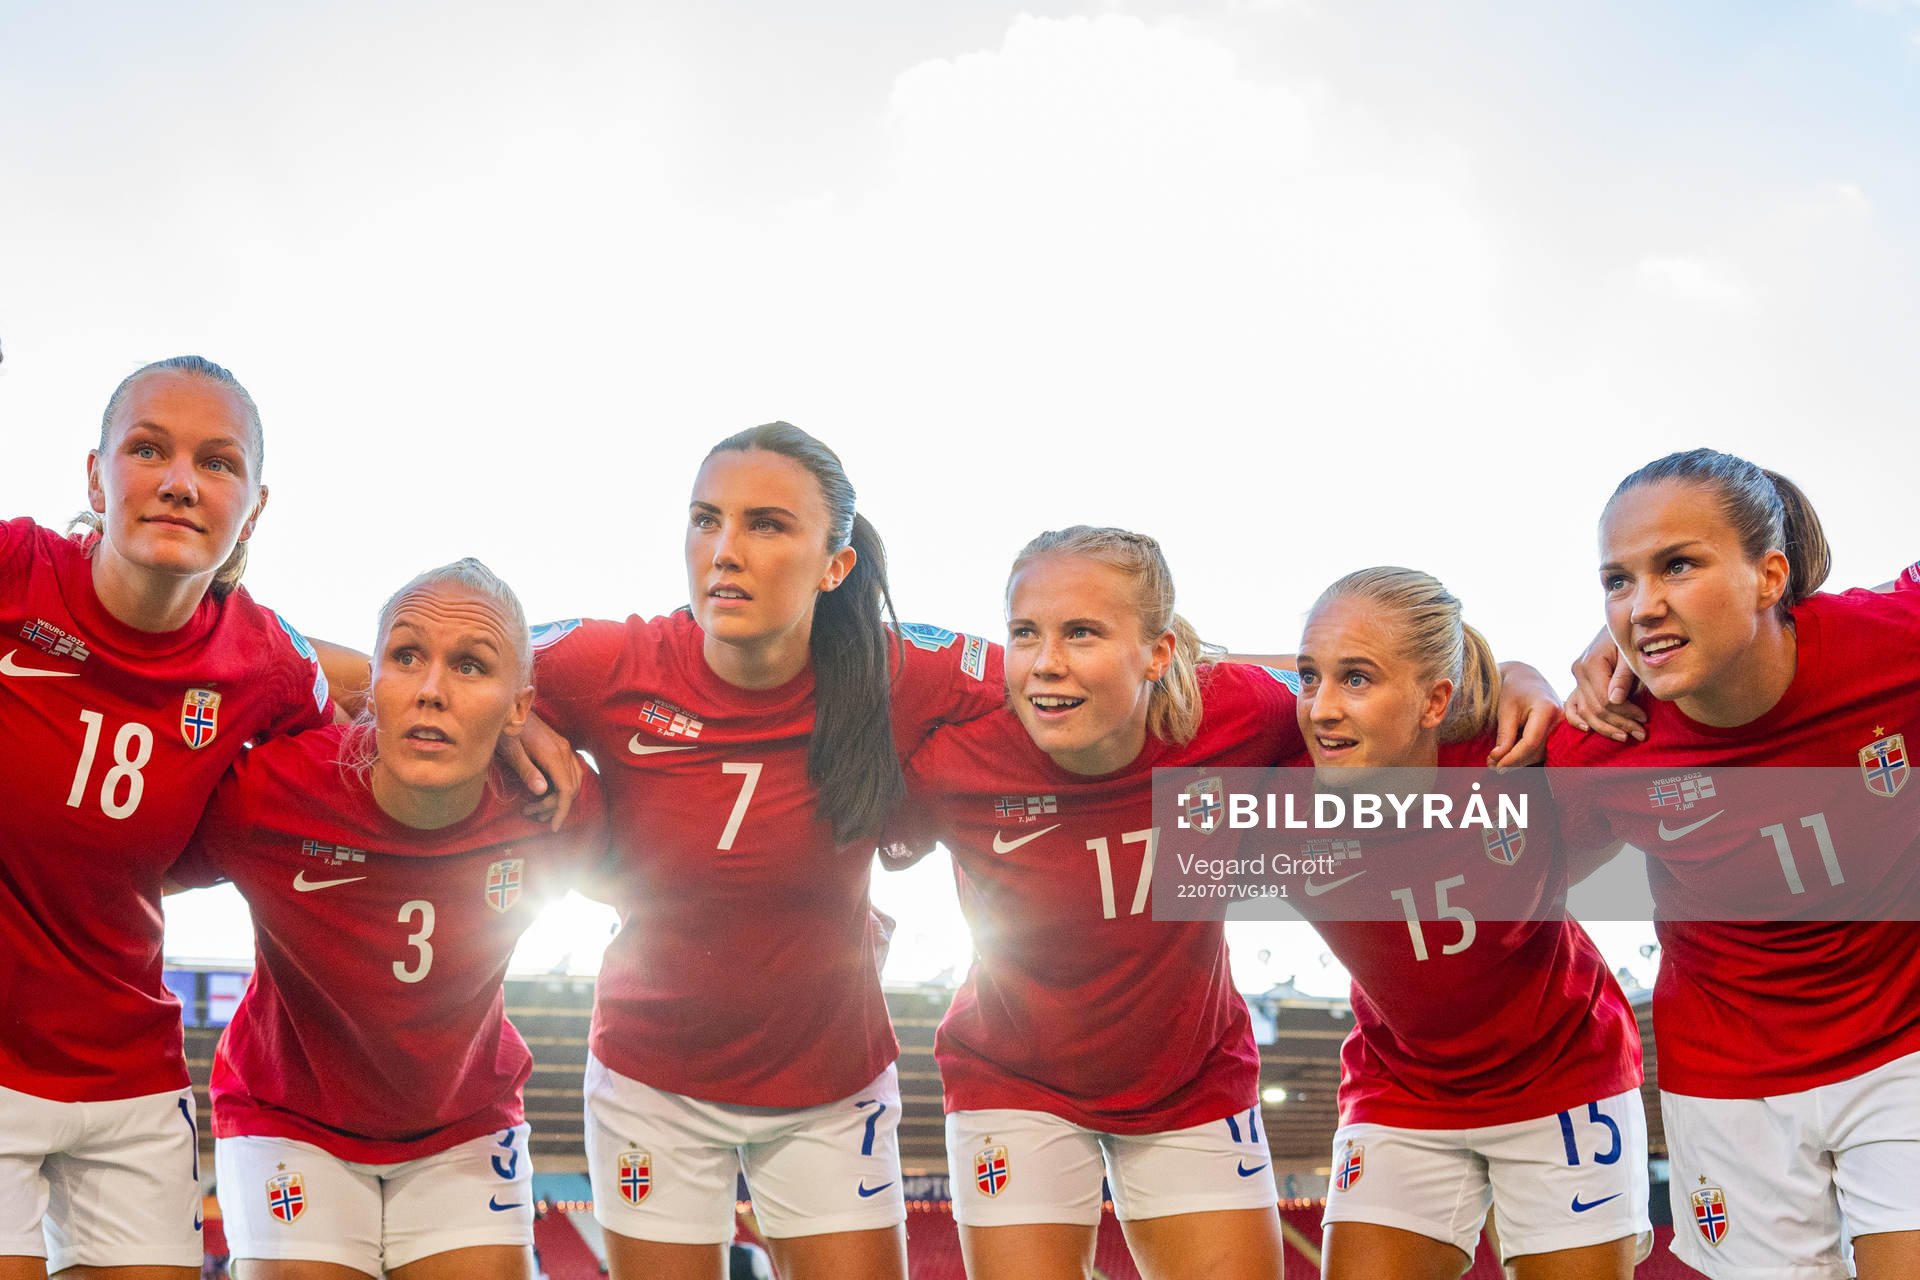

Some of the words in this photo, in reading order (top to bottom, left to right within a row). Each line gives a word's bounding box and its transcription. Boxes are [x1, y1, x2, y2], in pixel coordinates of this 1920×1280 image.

[37, 618, 66, 637] WEURO
[66, 634, 86, 648] 2022
[66, 709, 154, 820] 18
[716, 762, 764, 850] 7
[1653, 776, 1682, 787] WEURO
[1683, 772, 1703, 781] 2022
[1086, 826, 1161, 920] 17
[1759, 812, 1845, 895] 11
[392, 899, 436, 984] 3
[1390, 873, 1477, 962] 15
[489, 1127, 518, 1180] 3
[854, 1099, 887, 1156] 7
[1556, 1100, 1622, 1166] 15
